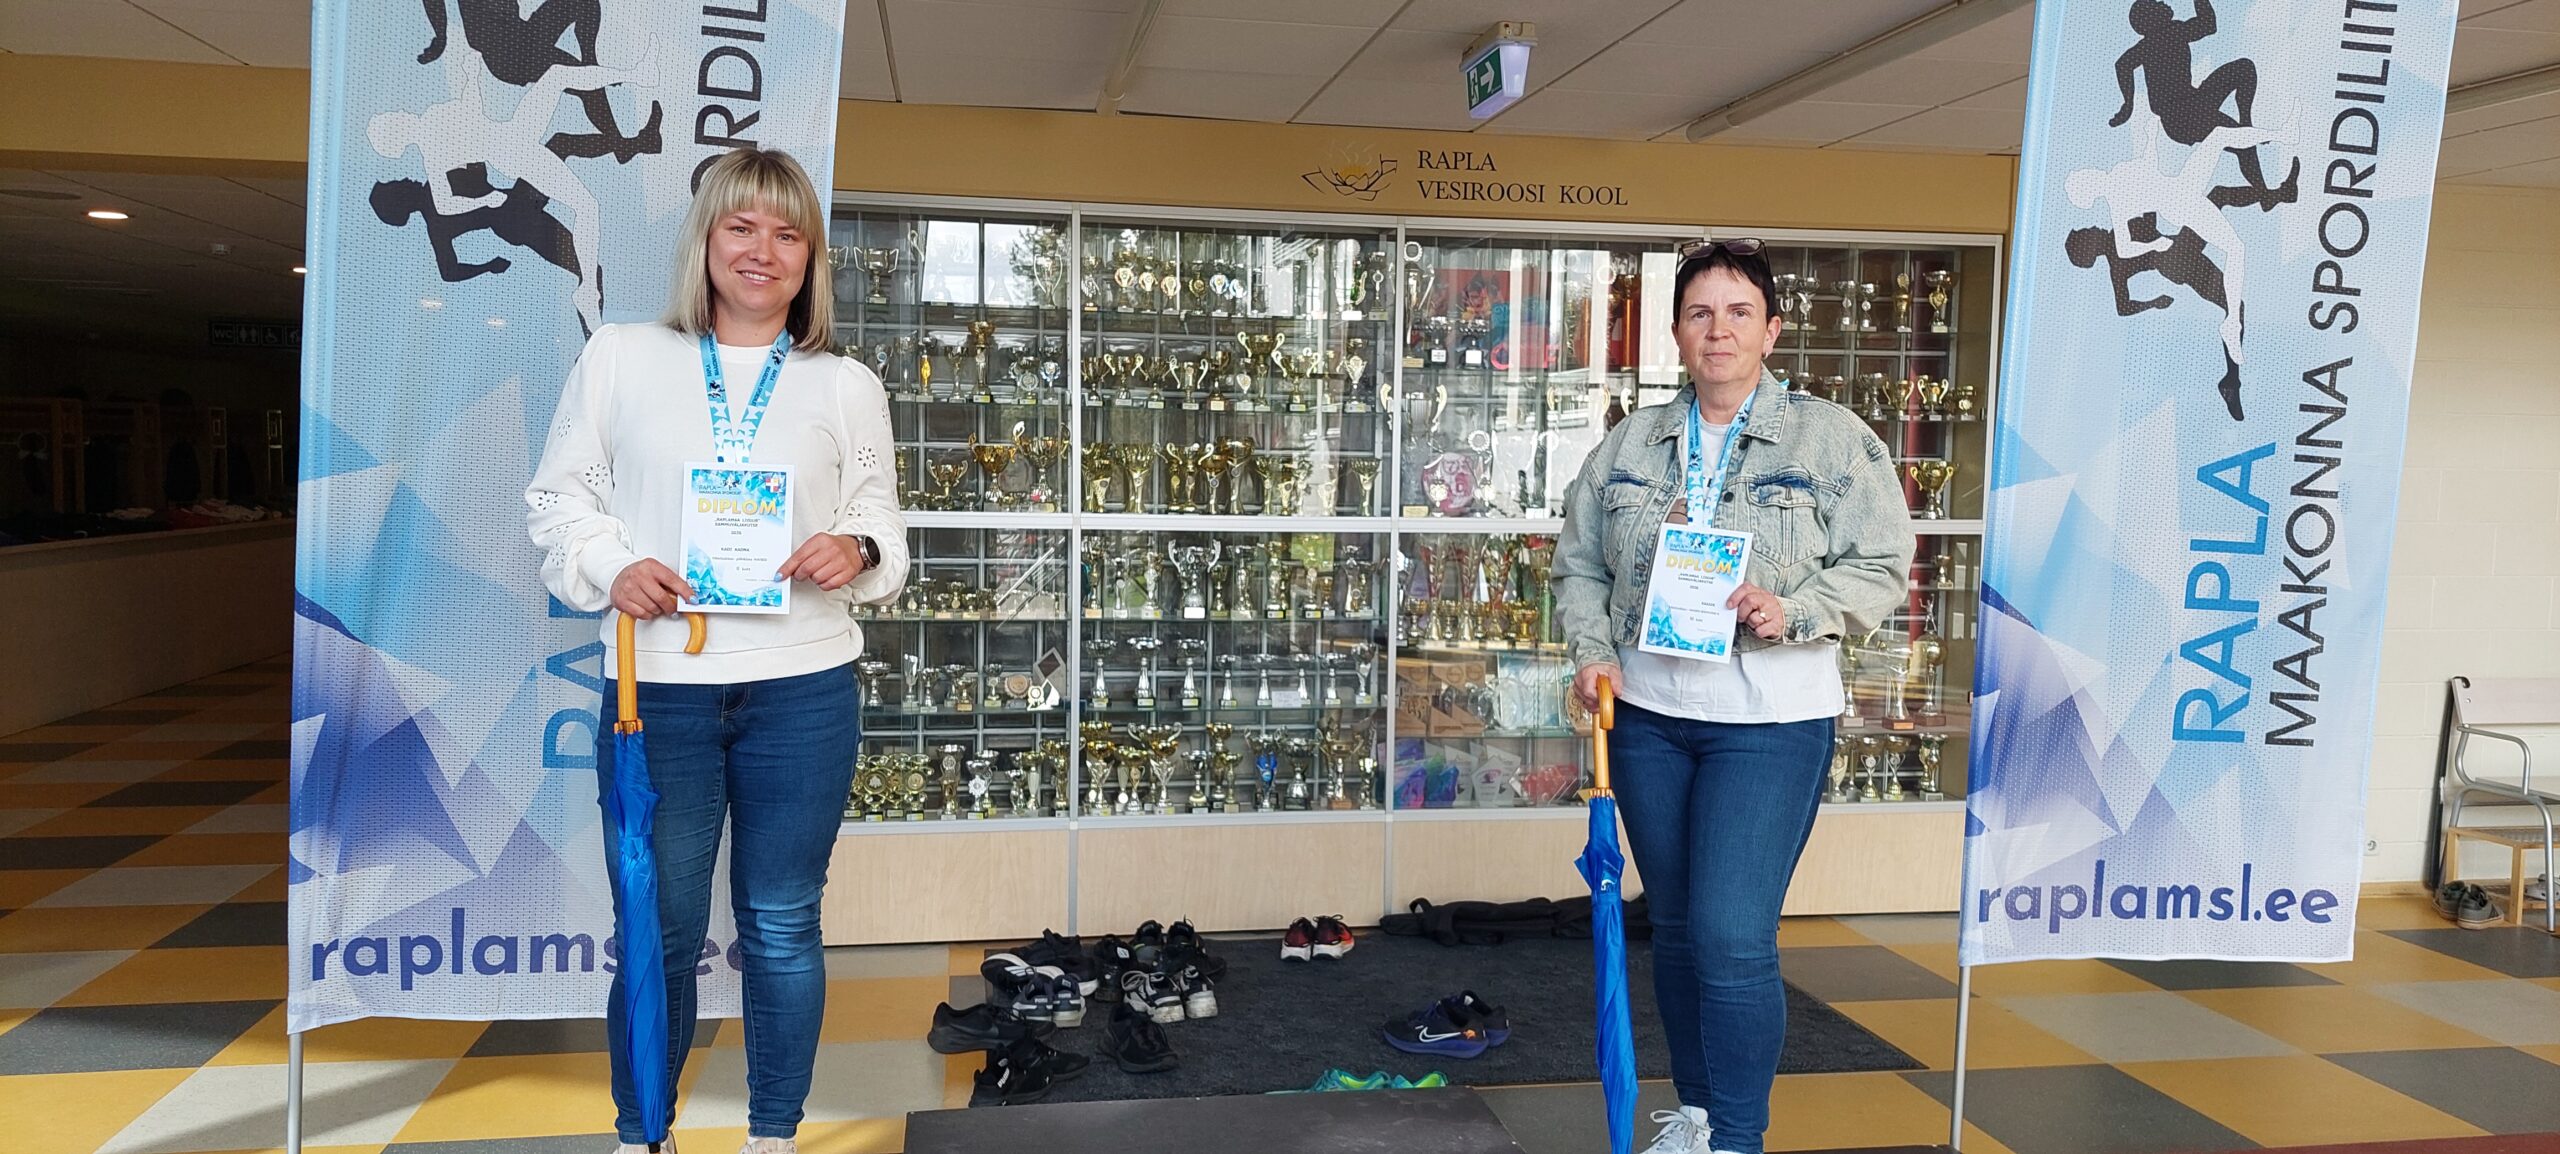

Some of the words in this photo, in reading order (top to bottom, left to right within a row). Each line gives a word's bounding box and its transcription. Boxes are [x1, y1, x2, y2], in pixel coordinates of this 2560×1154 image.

[1417, 149, 1497, 172] RAPLA
[2308, 0, 2398, 334] SPORDILIIT
[1417, 179, 1546, 204] VESIROOSI
[1559, 185, 1629, 206] KOOL
[214, 328, 234, 339] WC
[697, 497, 778, 517] DIPLOM
[1665, 554, 1732, 576] DIPLOM
[2265, 356, 2354, 747] MAAKONNA
[2172, 441, 2276, 744] RAPLA
[1978, 859, 2340, 934] raplamsl.ee
